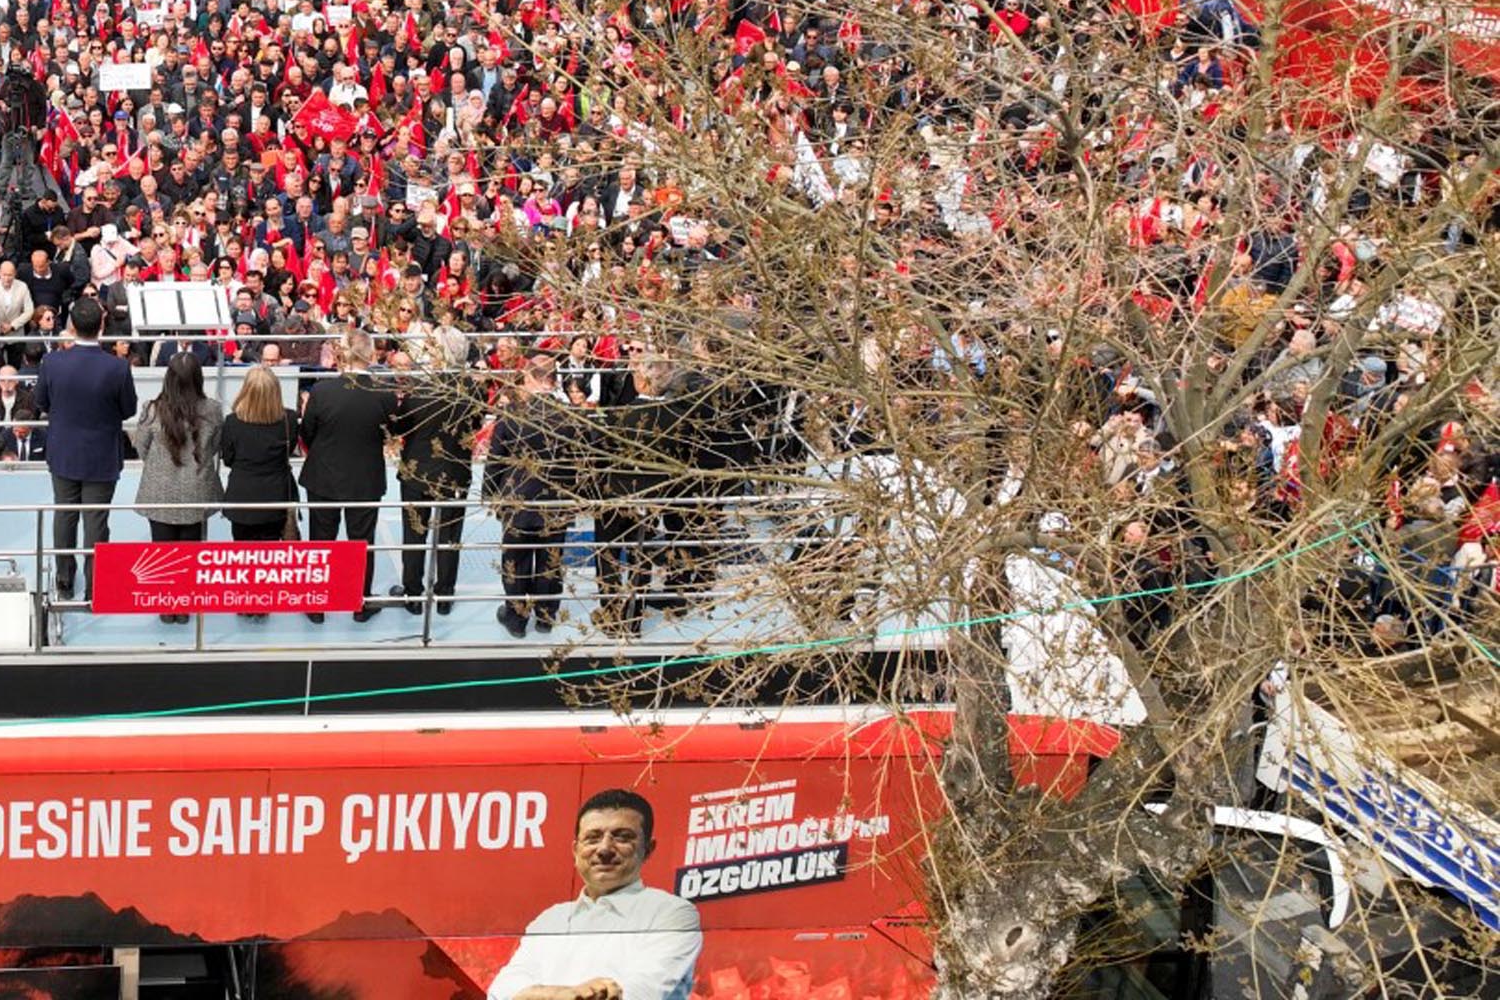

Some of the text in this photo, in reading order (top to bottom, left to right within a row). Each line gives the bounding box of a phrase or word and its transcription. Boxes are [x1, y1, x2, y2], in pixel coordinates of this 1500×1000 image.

[197, 546, 331, 566] CUMHURİYET
[196, 565, 330, 585] HALK PARTİSİ
[132, 590, 328, 610] Türkiye'nin Birinci Partisi
[340, 791, 548, 864] ÇIKIYOR
[688, 792, 796, 835] EKREM
[680, 849, 840, 899] ÖZGÜRLÜK
